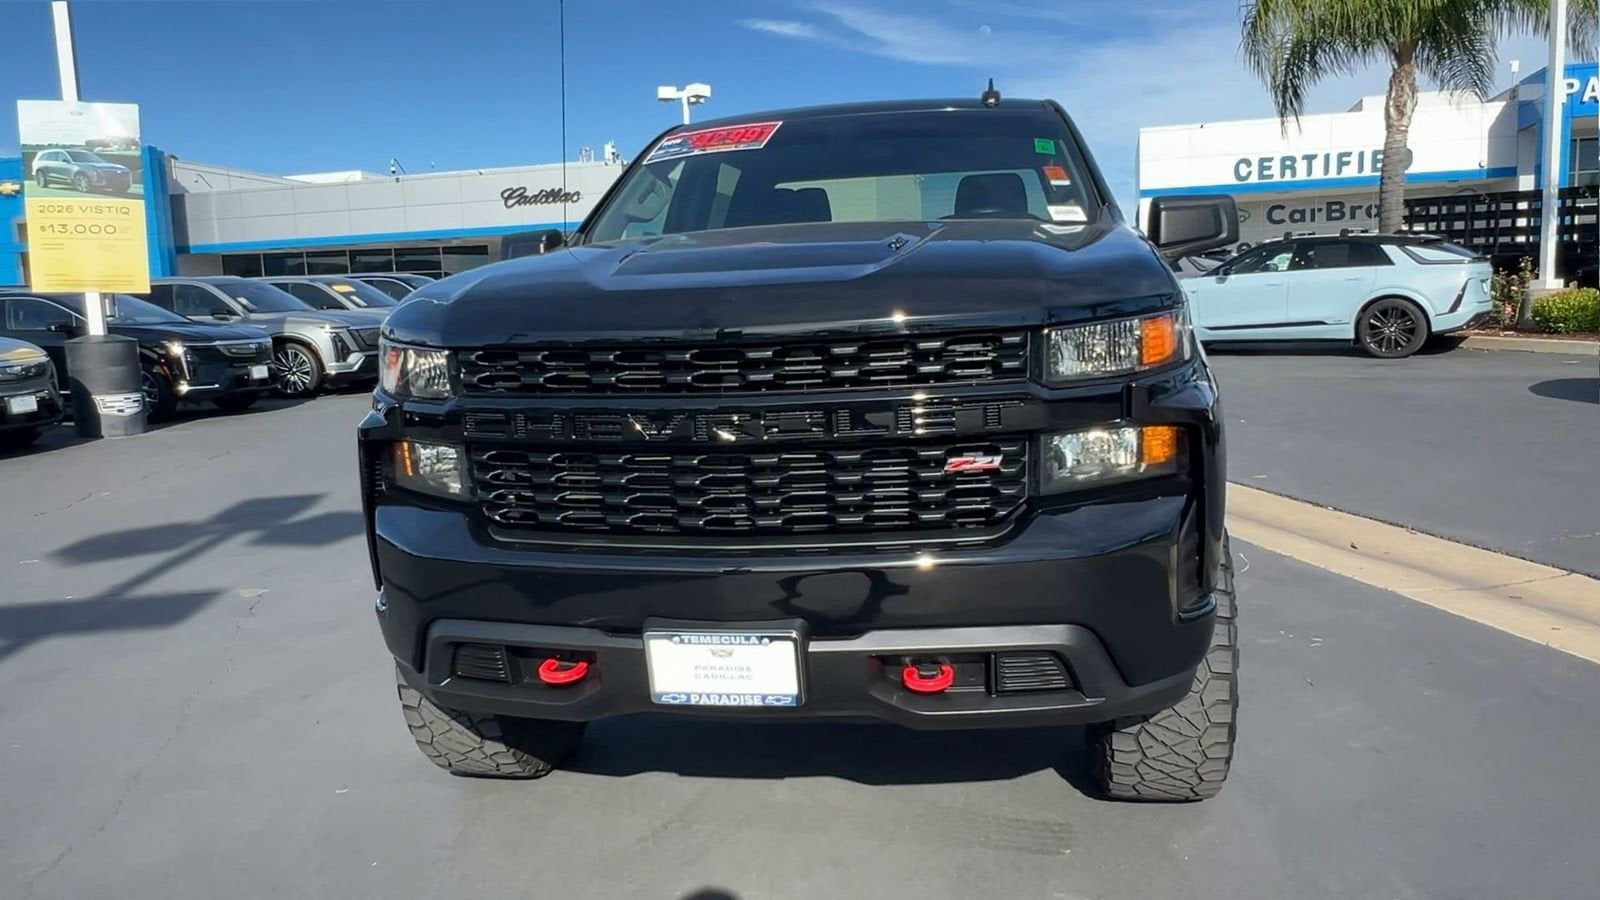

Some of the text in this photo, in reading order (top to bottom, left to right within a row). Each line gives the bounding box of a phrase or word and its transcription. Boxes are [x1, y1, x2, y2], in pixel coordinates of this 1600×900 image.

[500, 186, 581, 209] Cadillac
[38, 204, 131, 216] 2026 VISTIQ
[39, 223, 118, 236] $13,000
[463, 401, 1024, 442] CHEVROLET
[680, 635, 760, 646] TEMECULA
[693, 664, 754, 673] PARADISE
[694, 673, 754, 681] CADILLAC
[690, 693, 764, 706] PARADISE
